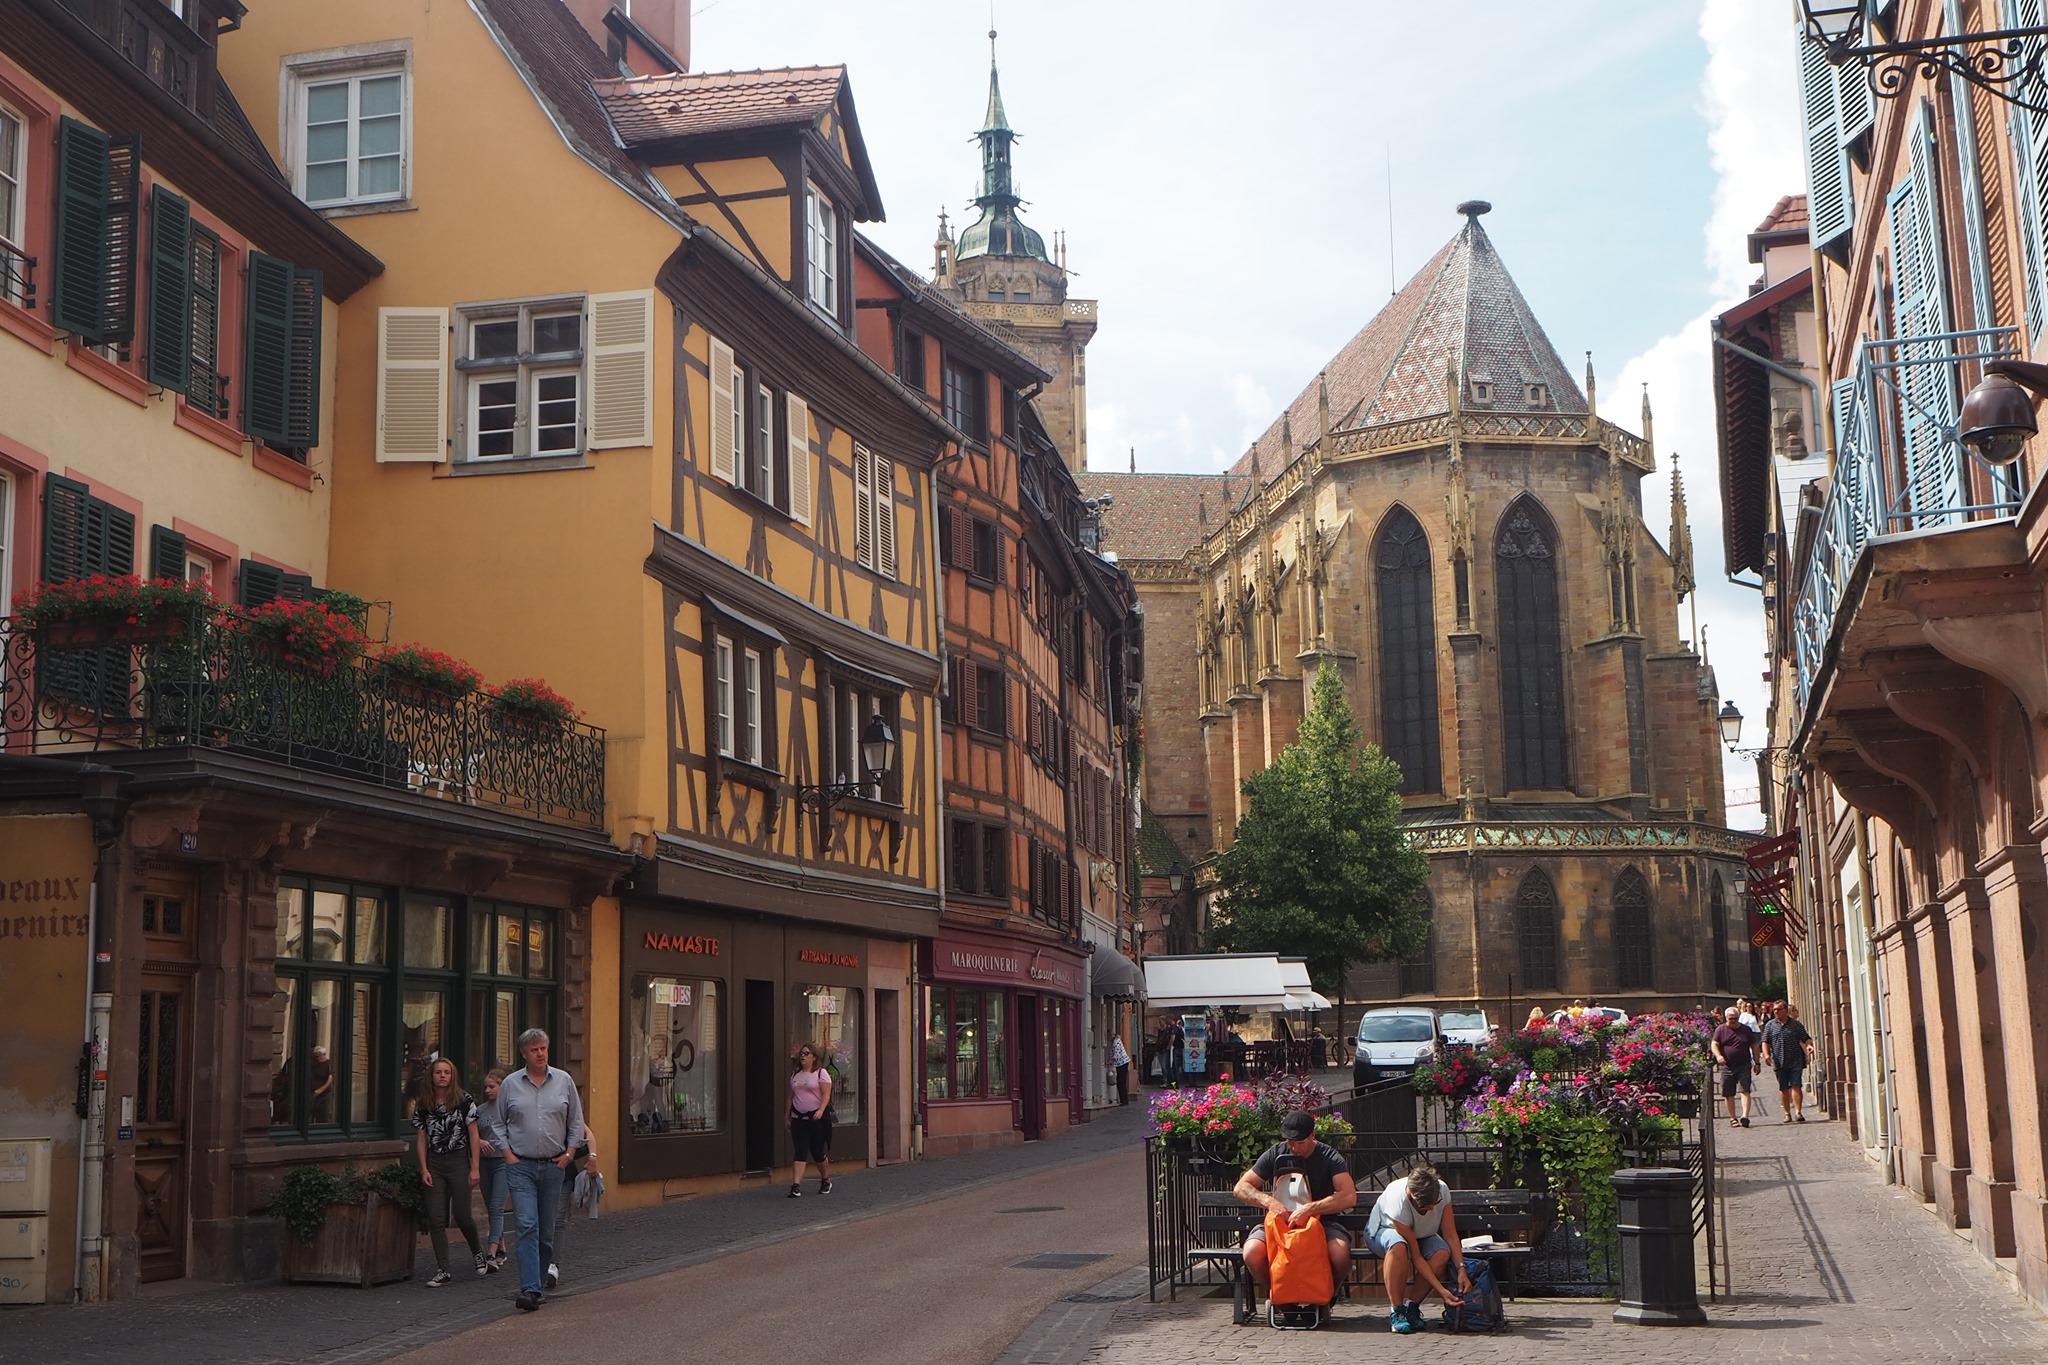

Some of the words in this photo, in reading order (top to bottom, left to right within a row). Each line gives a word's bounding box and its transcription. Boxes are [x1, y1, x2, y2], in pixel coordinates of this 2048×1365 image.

[184, 834, 197, 849] 20
[644, 931, 720, 956] NAMASTE
[951, 951, 1019, 973] MAROQUINERIE
